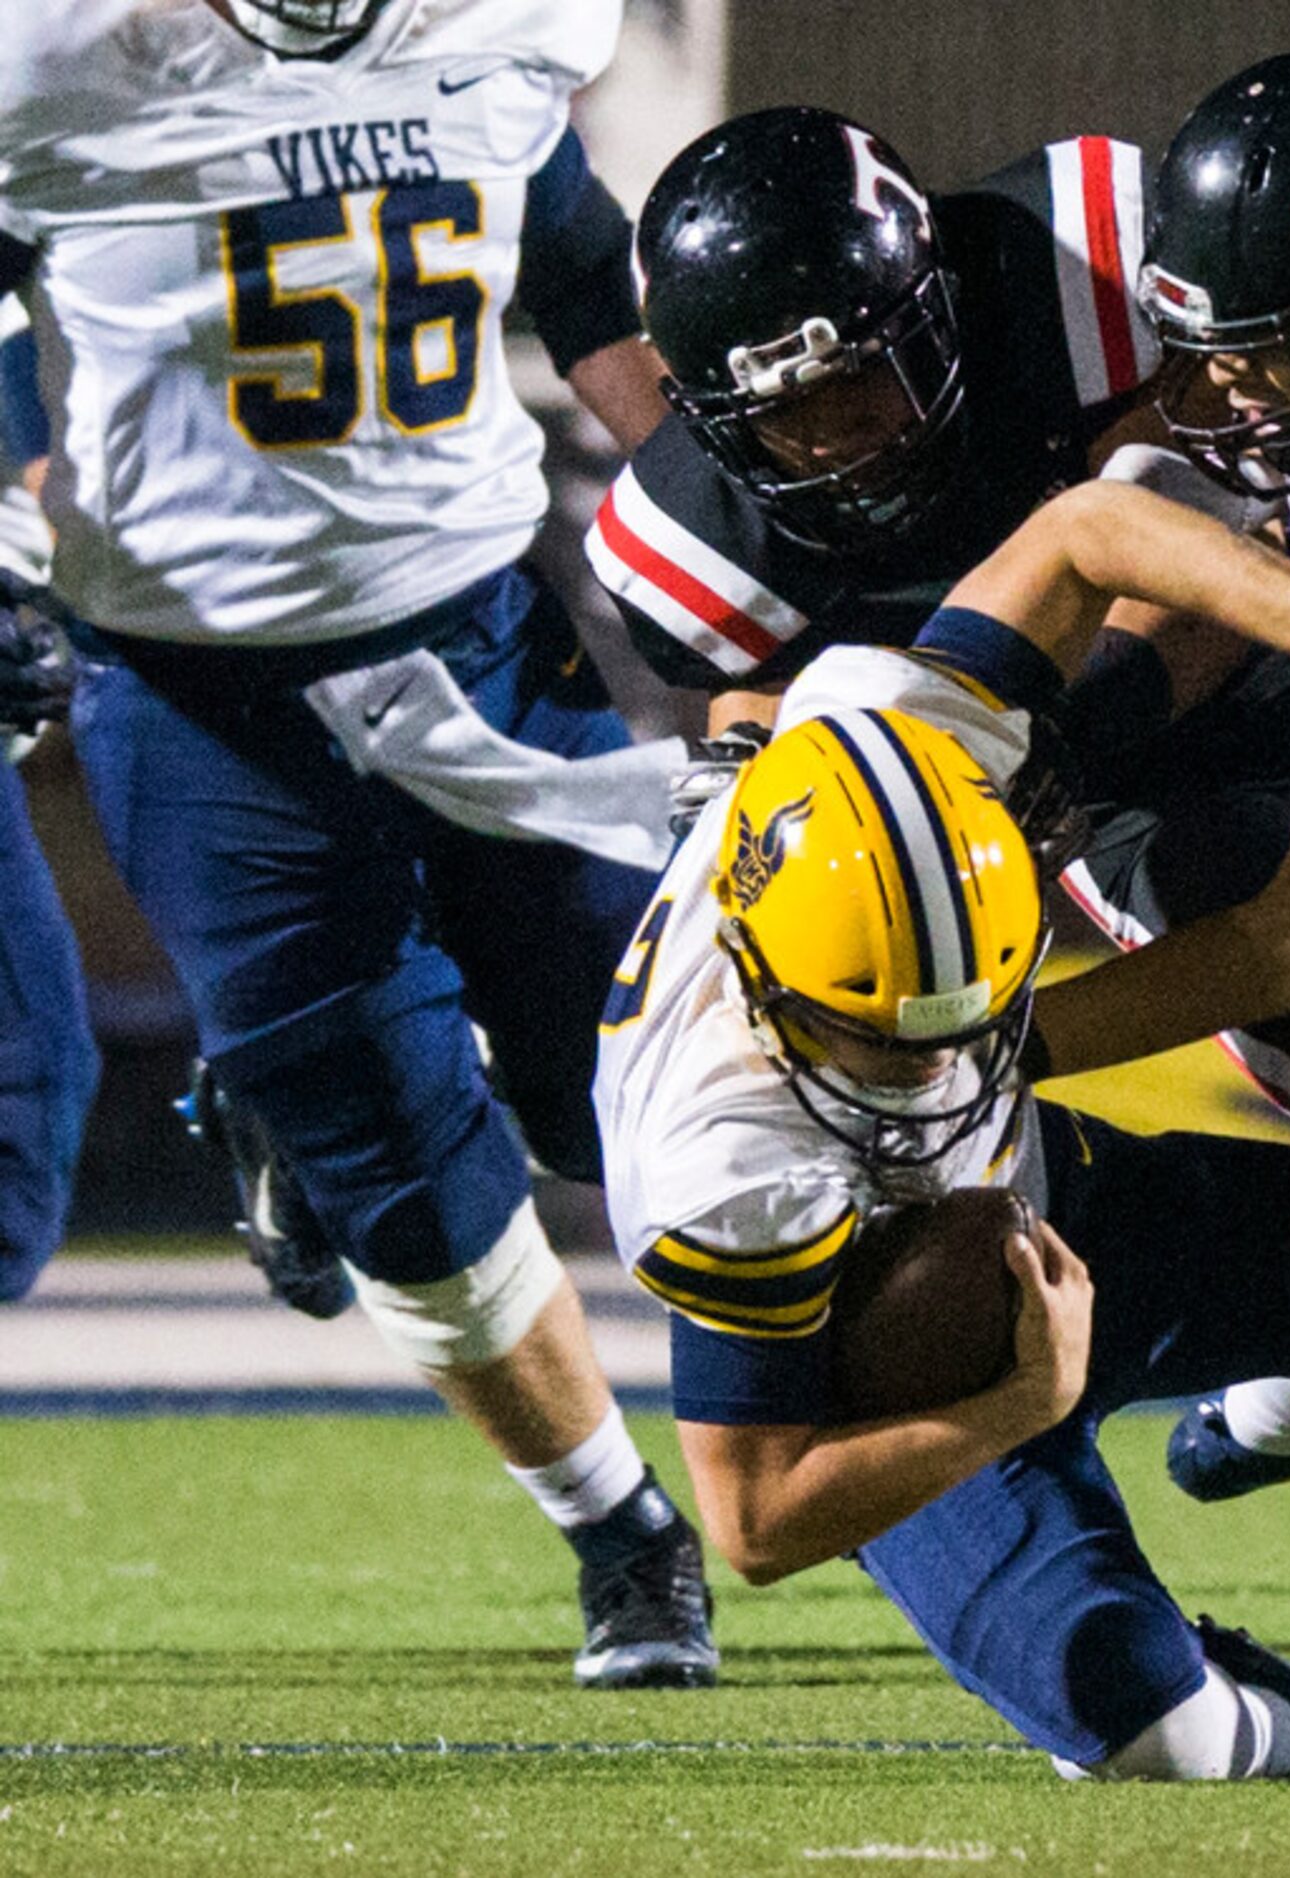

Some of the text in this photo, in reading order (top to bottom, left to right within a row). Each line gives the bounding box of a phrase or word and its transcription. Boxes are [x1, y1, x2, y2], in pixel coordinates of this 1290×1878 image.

[267, 118, 440, 199] VIKES
[841, 124, 932, 242] T
[219, 178, 491, 451] 56
